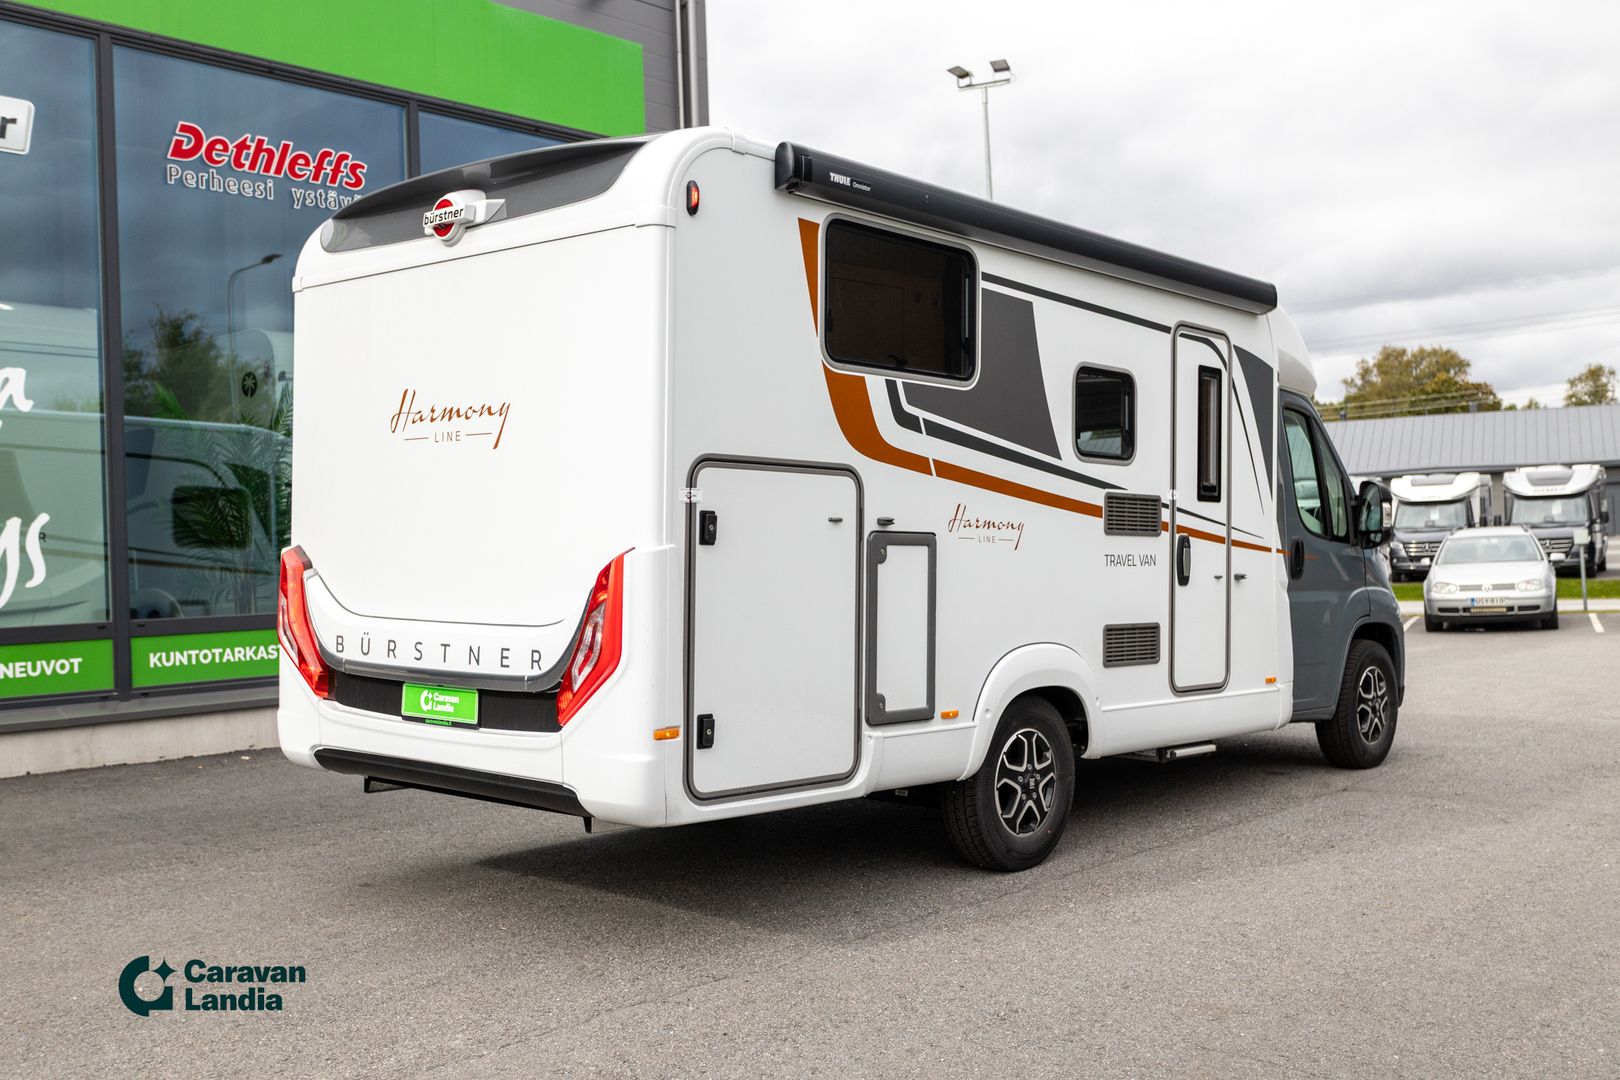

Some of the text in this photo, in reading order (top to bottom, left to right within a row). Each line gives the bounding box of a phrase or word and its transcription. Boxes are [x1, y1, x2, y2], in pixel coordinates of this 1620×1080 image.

[167, 121, 367, 190] Dethleffs
[166, 164, 362, 210] Perheesi ystäv
[829, 172, 851, 187] THULE
[424, 208, 464, 225] bürstner
[391, 388, 511, 450] Harmony
[434, 430, 461, 443] LINE
[948, 503, 1024, 550] Harmony
[978, 535, 996, 544] LINE
[1104, 554, 1157, 567] TRAVEL VAN
[149, 645, 280, 668] KUNTOTARKAS
[335, 632, 543, 671] BÜRSTNER
[433, 692, 460, 704] Caravan
[433, 701, 454, 713] Landia
